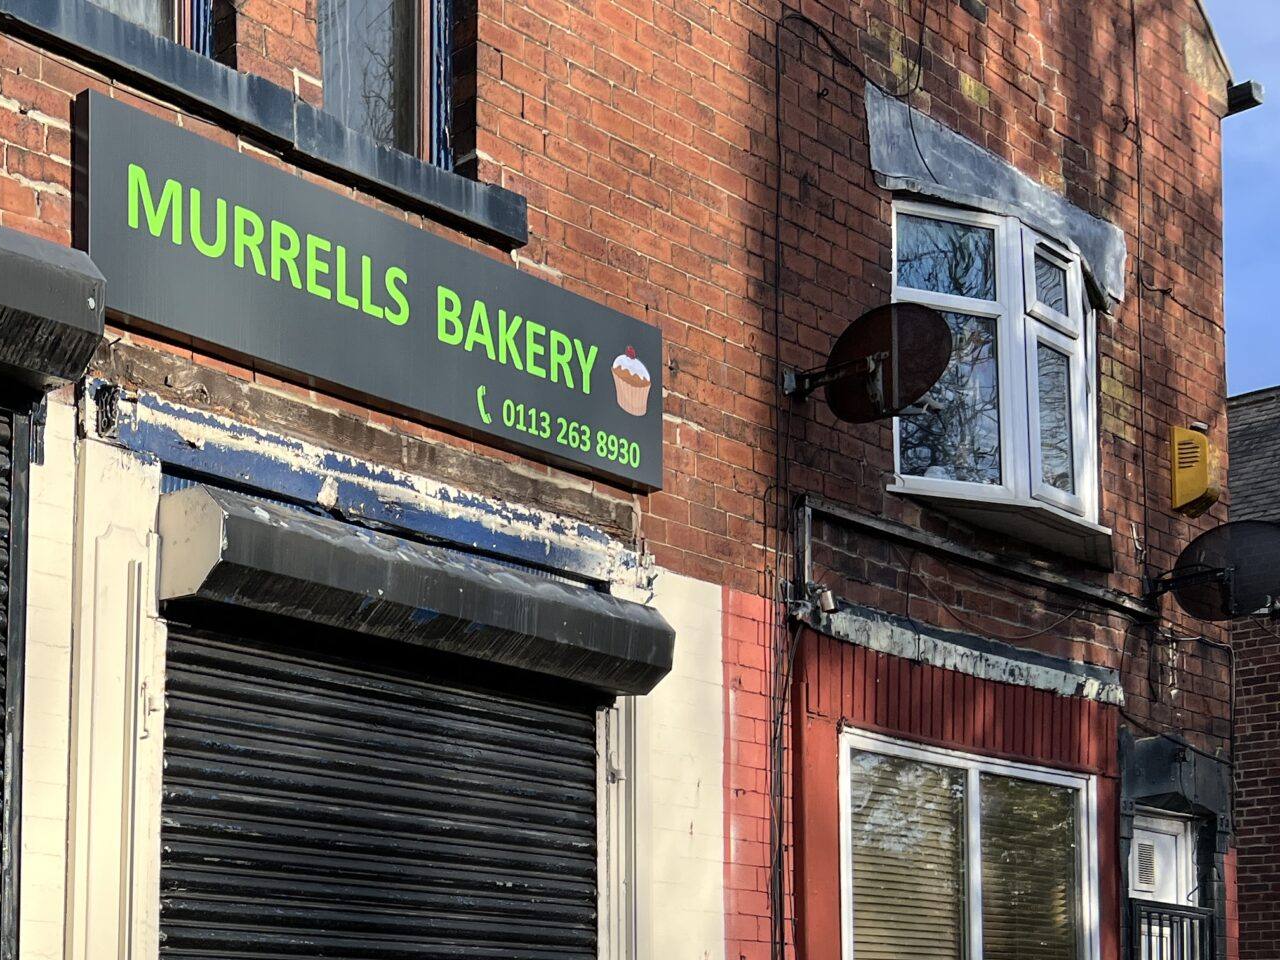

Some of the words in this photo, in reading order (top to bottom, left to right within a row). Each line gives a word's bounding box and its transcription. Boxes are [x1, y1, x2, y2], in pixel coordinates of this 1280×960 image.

[128, 163, 410, 326] MURRELLS
[437, 285, 598, 395] BAKERY
[502, 399, 551, 439] 0113
[556, 417, 591, 452] 263
[596, 431, 641, 468] 8930
